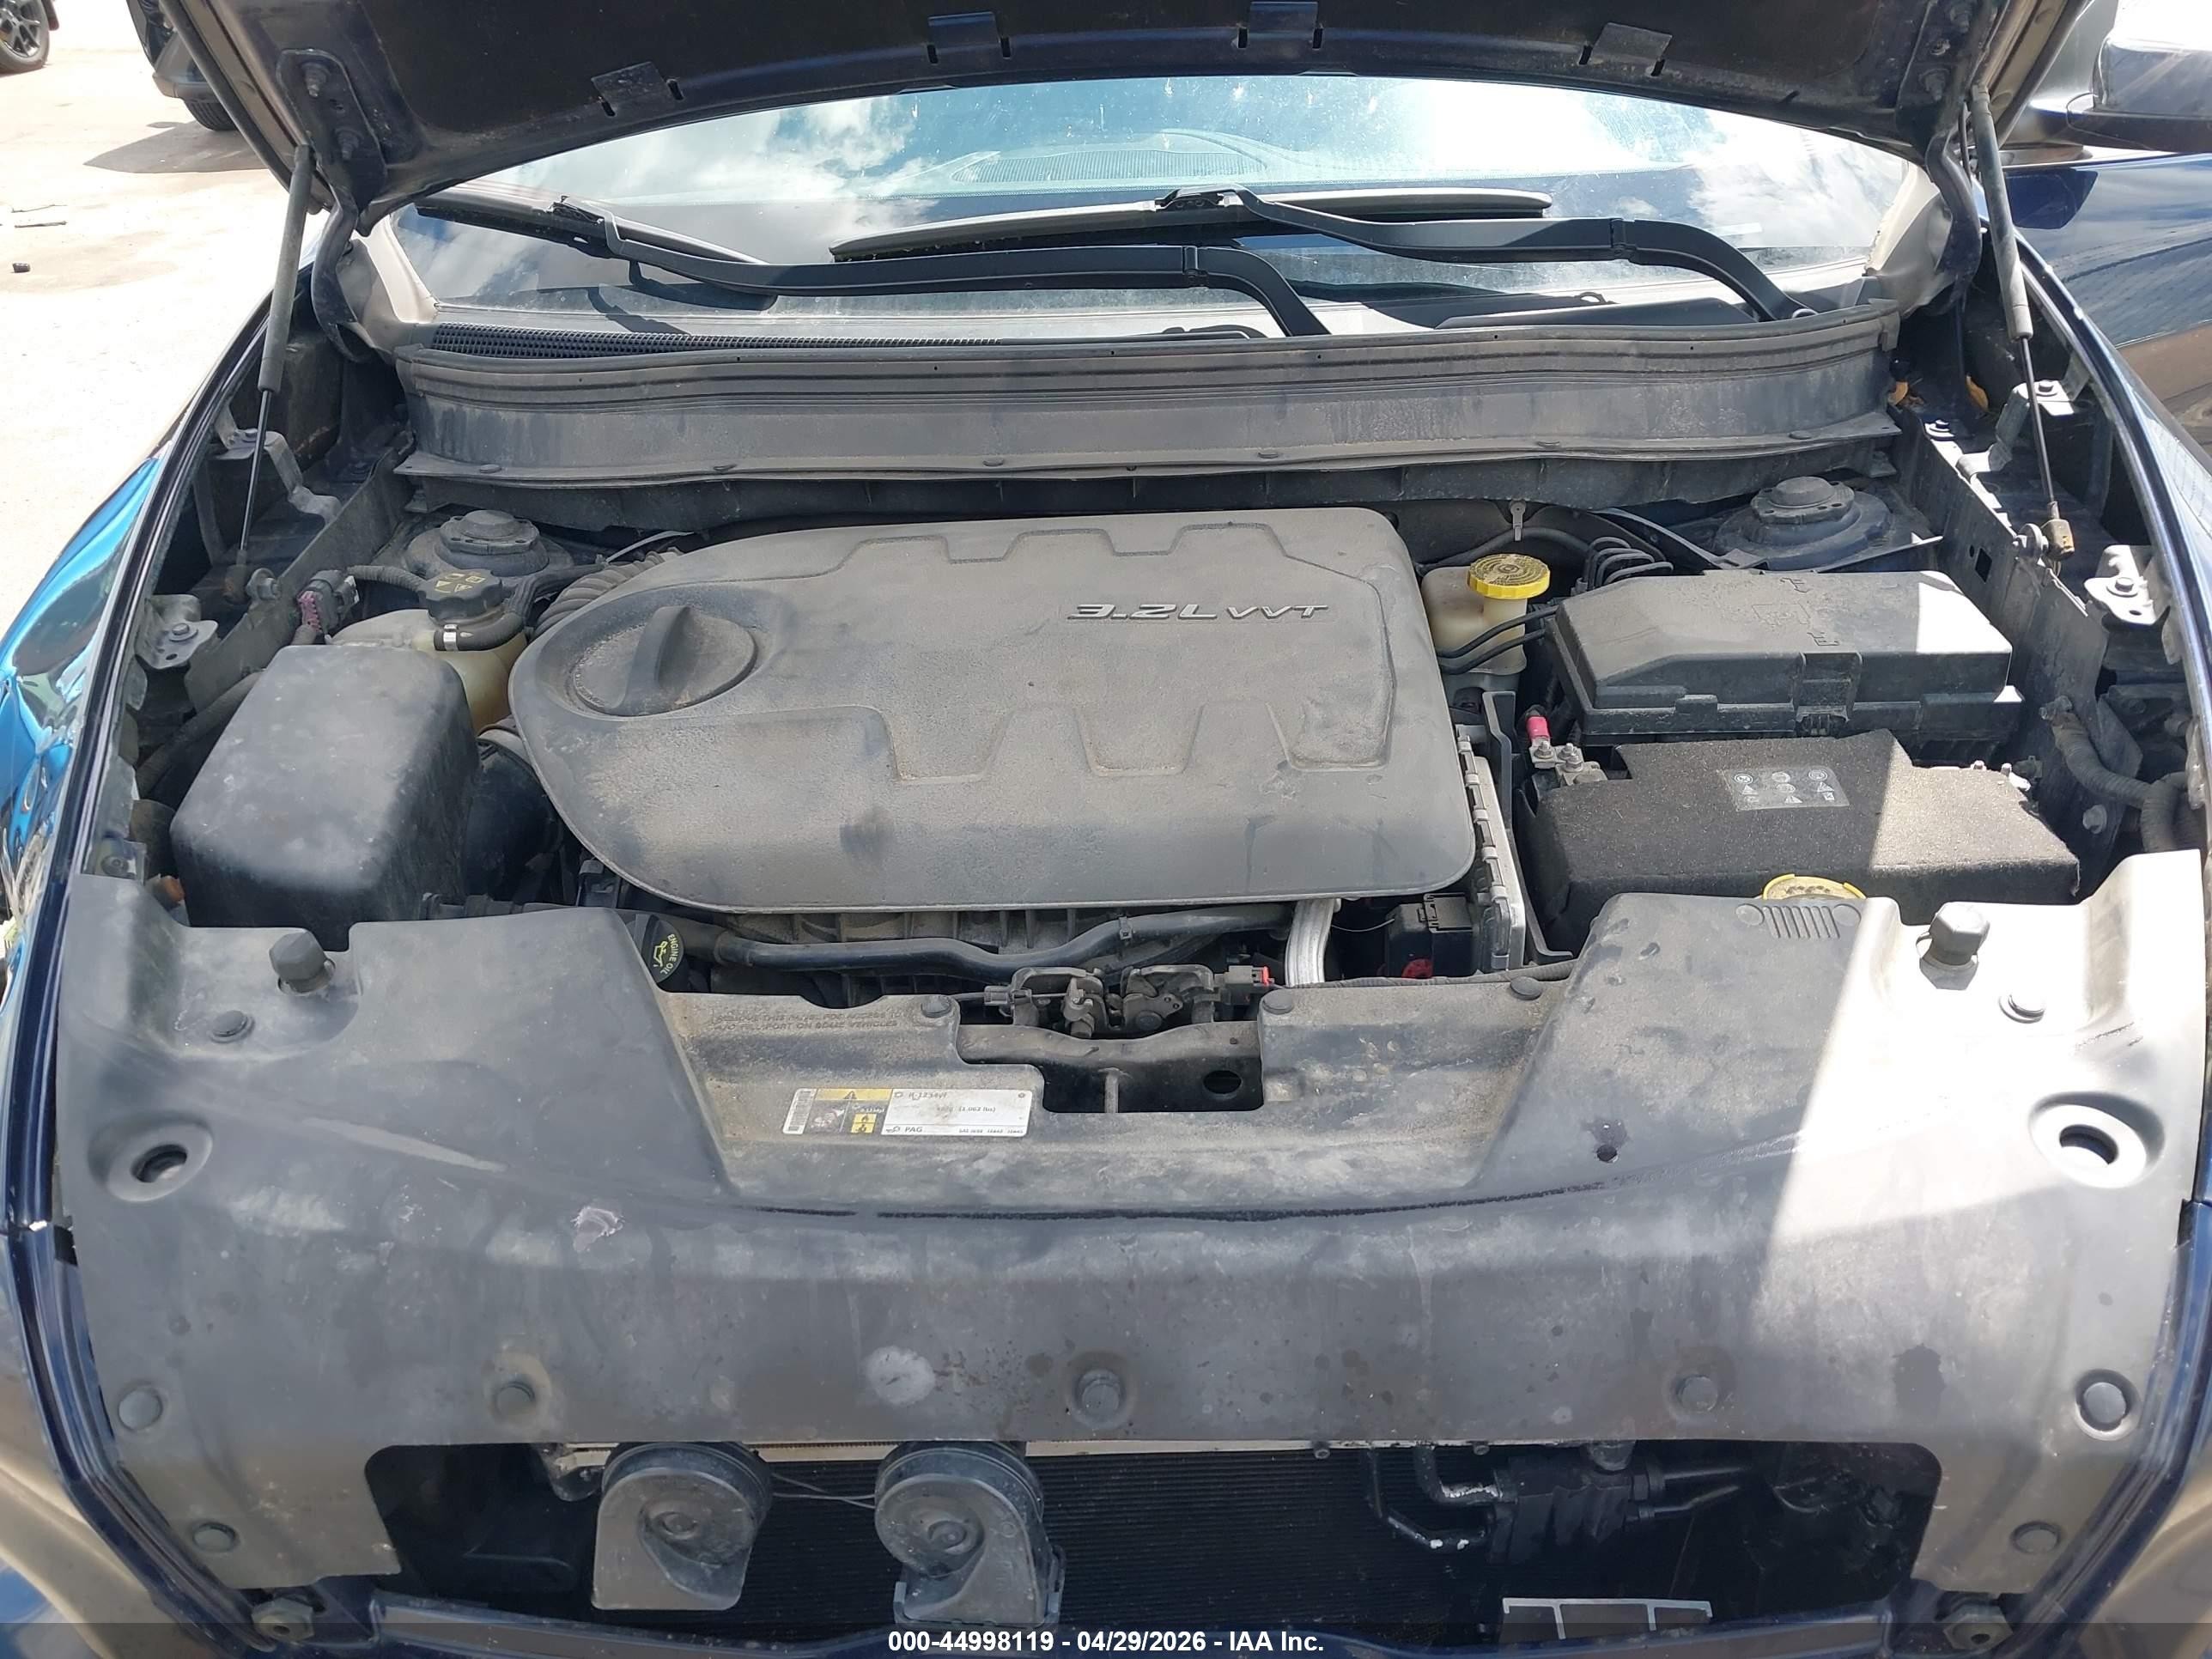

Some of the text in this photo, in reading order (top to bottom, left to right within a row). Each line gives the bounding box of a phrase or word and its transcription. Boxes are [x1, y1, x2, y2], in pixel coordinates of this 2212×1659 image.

[1067, 603, 1328, 620] 3.2L VVT
[659, 933, 679, 975] ENGINE OIL
